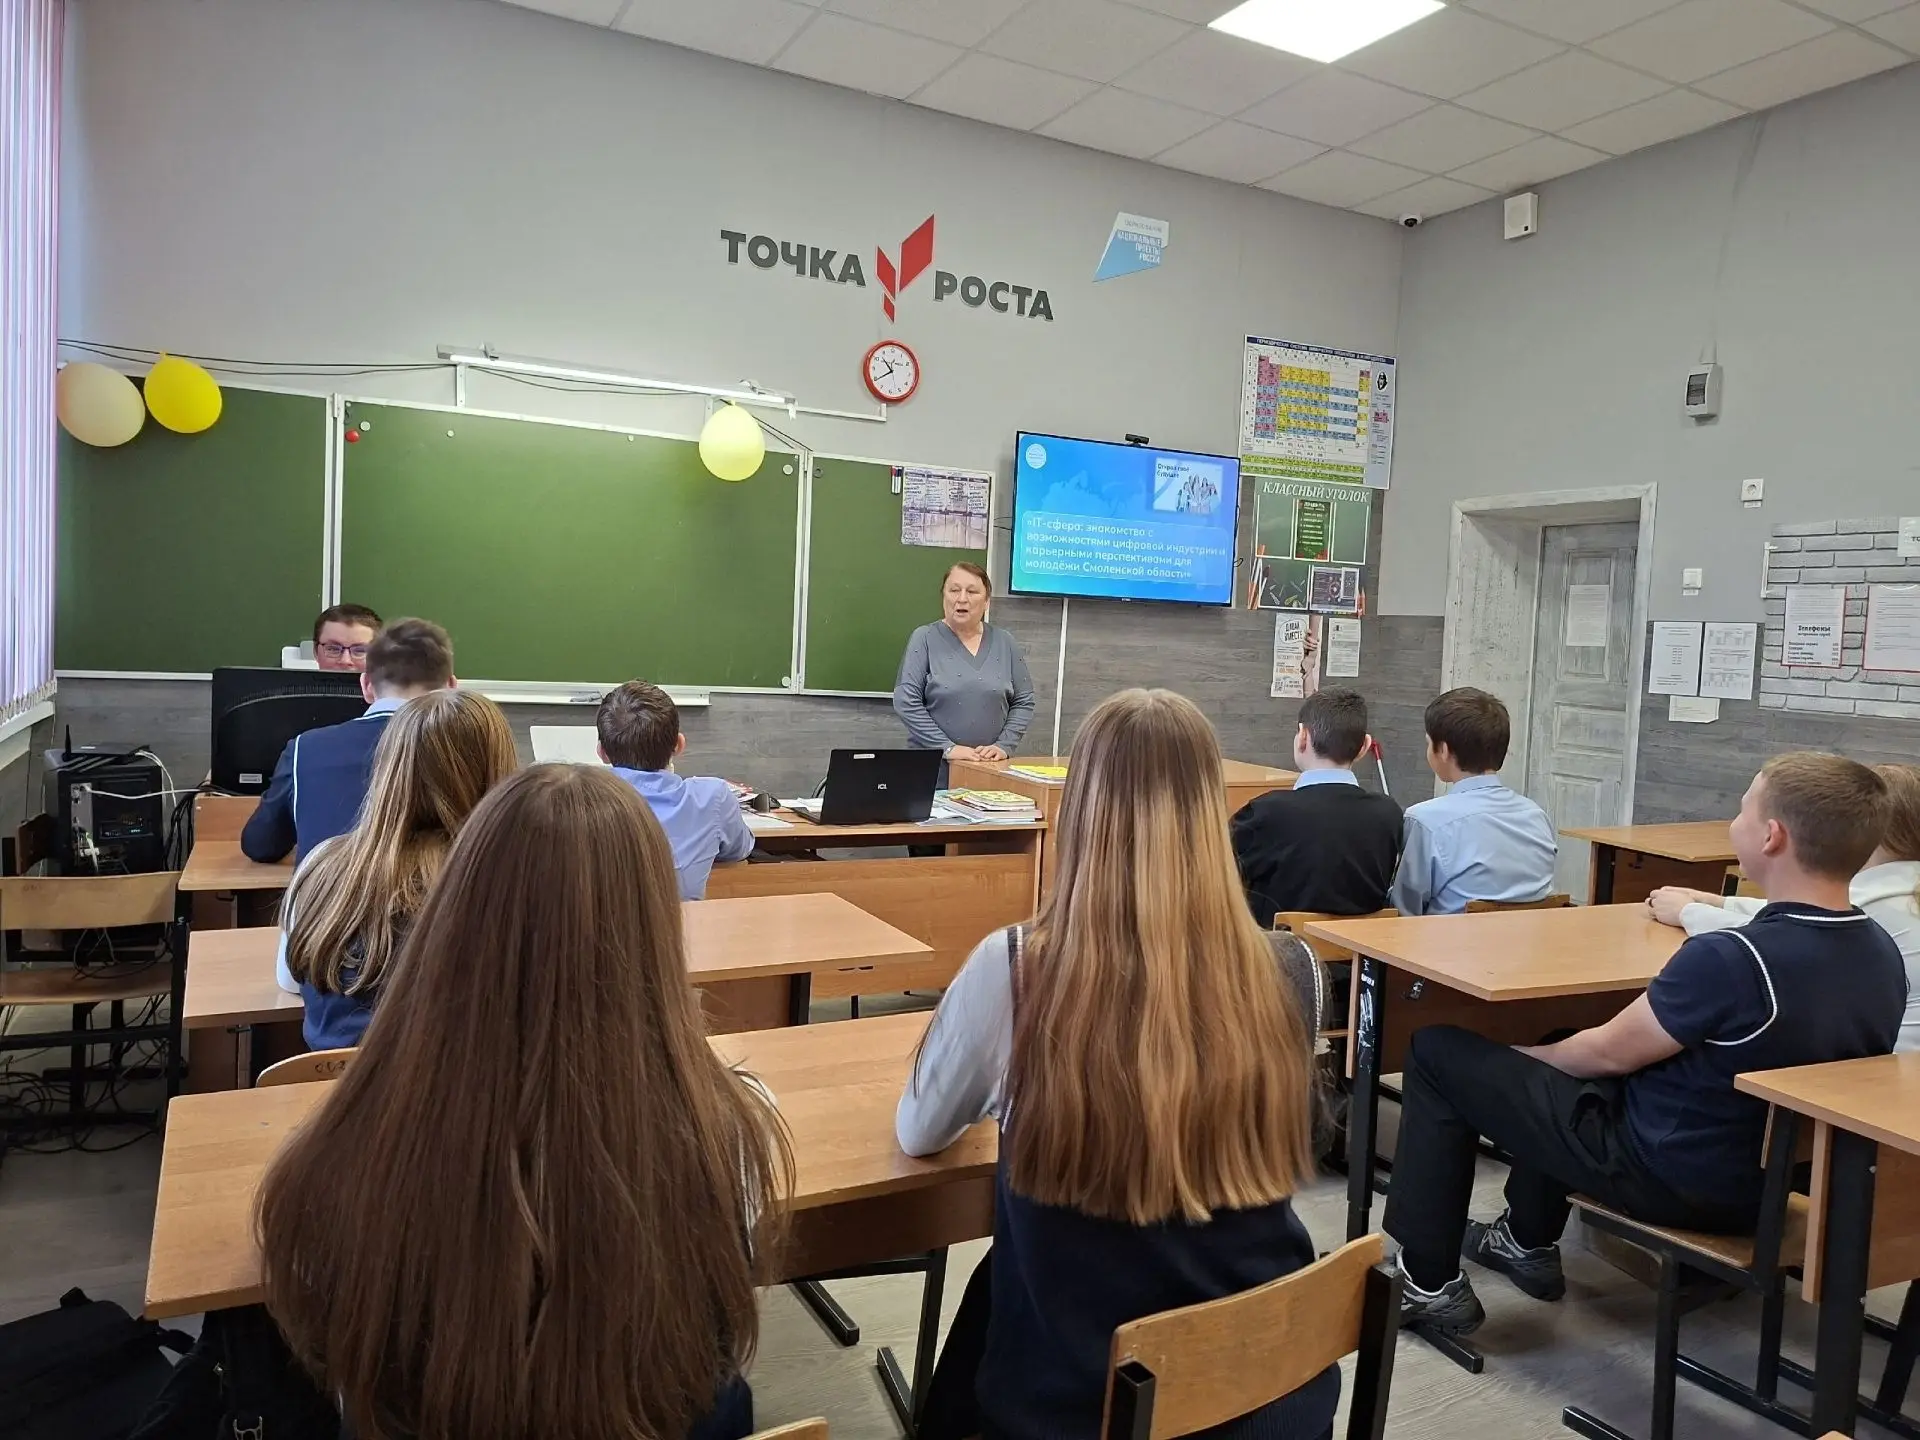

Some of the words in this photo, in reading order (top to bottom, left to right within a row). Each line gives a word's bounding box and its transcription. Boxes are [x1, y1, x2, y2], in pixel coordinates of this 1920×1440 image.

[720, 229, 866, 287] ТОЧКА
[934, 270, 1054, 321] РОСТА
[1263, 481, 1325, 499] КЛАССНЫЙ
[1326, 488, 1369, 503] УГОЛОК
[1087, 525, 1145, 537] знакомство
[1148, 529, 1154, 538] с
[1026, 532, 1110, 547] возможностями
[1113, 539, 1164, 552] цифровой
[1166, 544, 1217, 556] индустрии
[1026, 546, 1093, 559] карьерными
[1095, 552, 1173, 565] перспективами
[1174, 557, 1192, 568] для
[1025, 560, 1080, 572] молодёжи
[1082, 562, 1144, 576] Смоленской
[1147, 566, 1192, 579] области»
